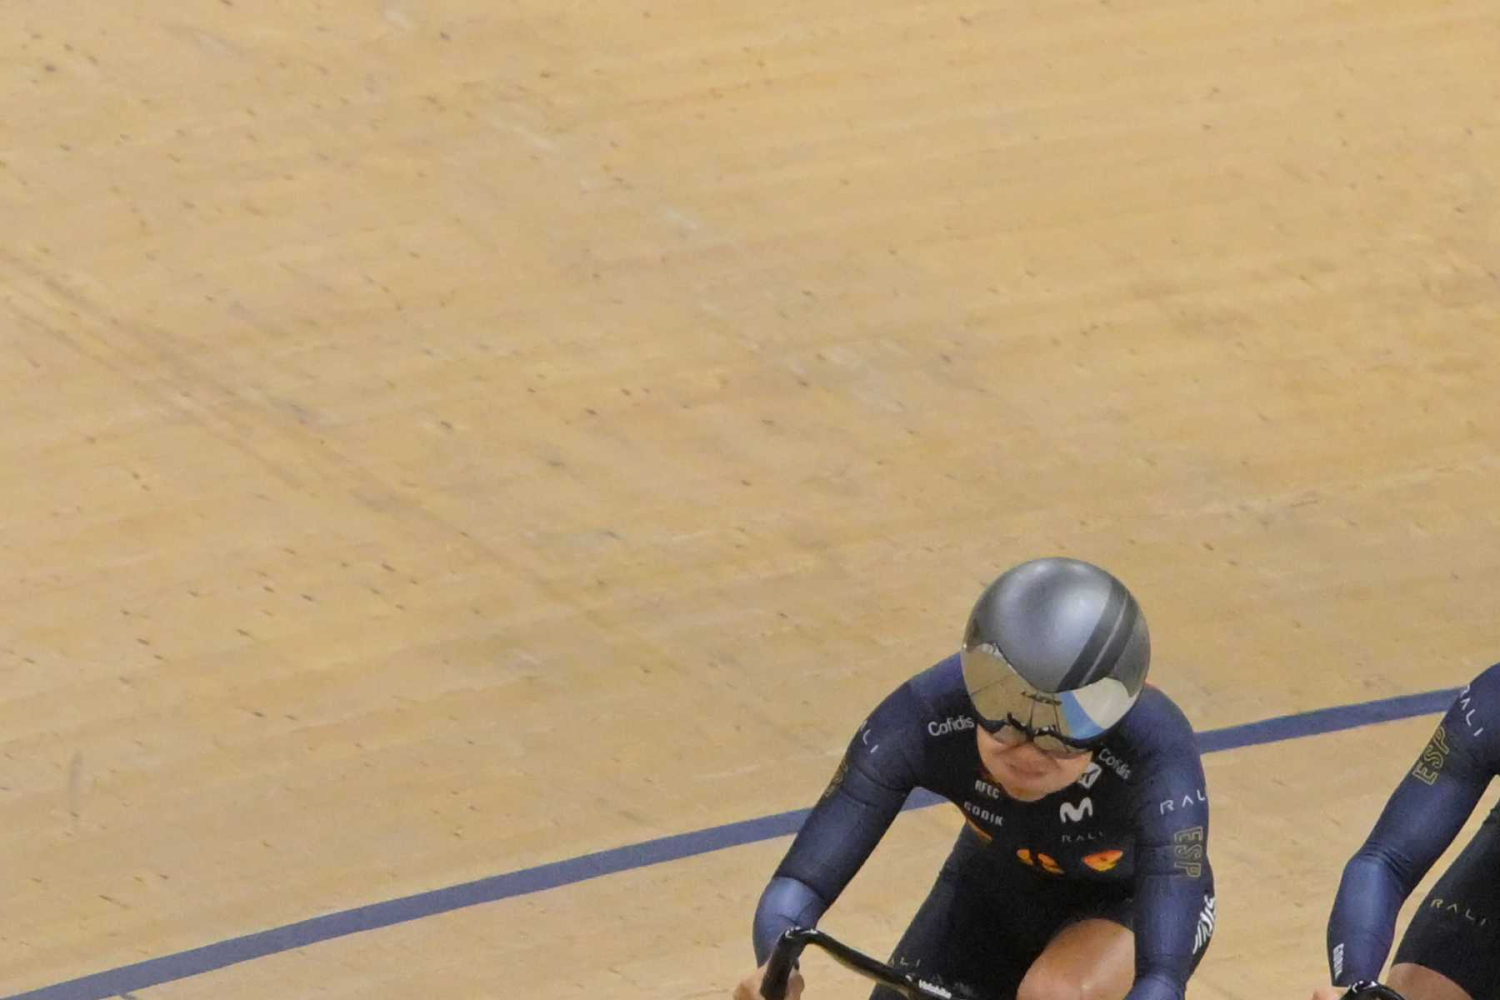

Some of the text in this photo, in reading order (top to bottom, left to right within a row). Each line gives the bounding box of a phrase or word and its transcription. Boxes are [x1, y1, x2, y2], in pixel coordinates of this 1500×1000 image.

[928, 713, 976, 737] Cofidis
[1411, 726, 1450, 786] ESP
[974, 779, 1001, 799] RFEC
[1174, 826, 1204, 879] ESP
[1429, 898, 1487, 927] RALI
